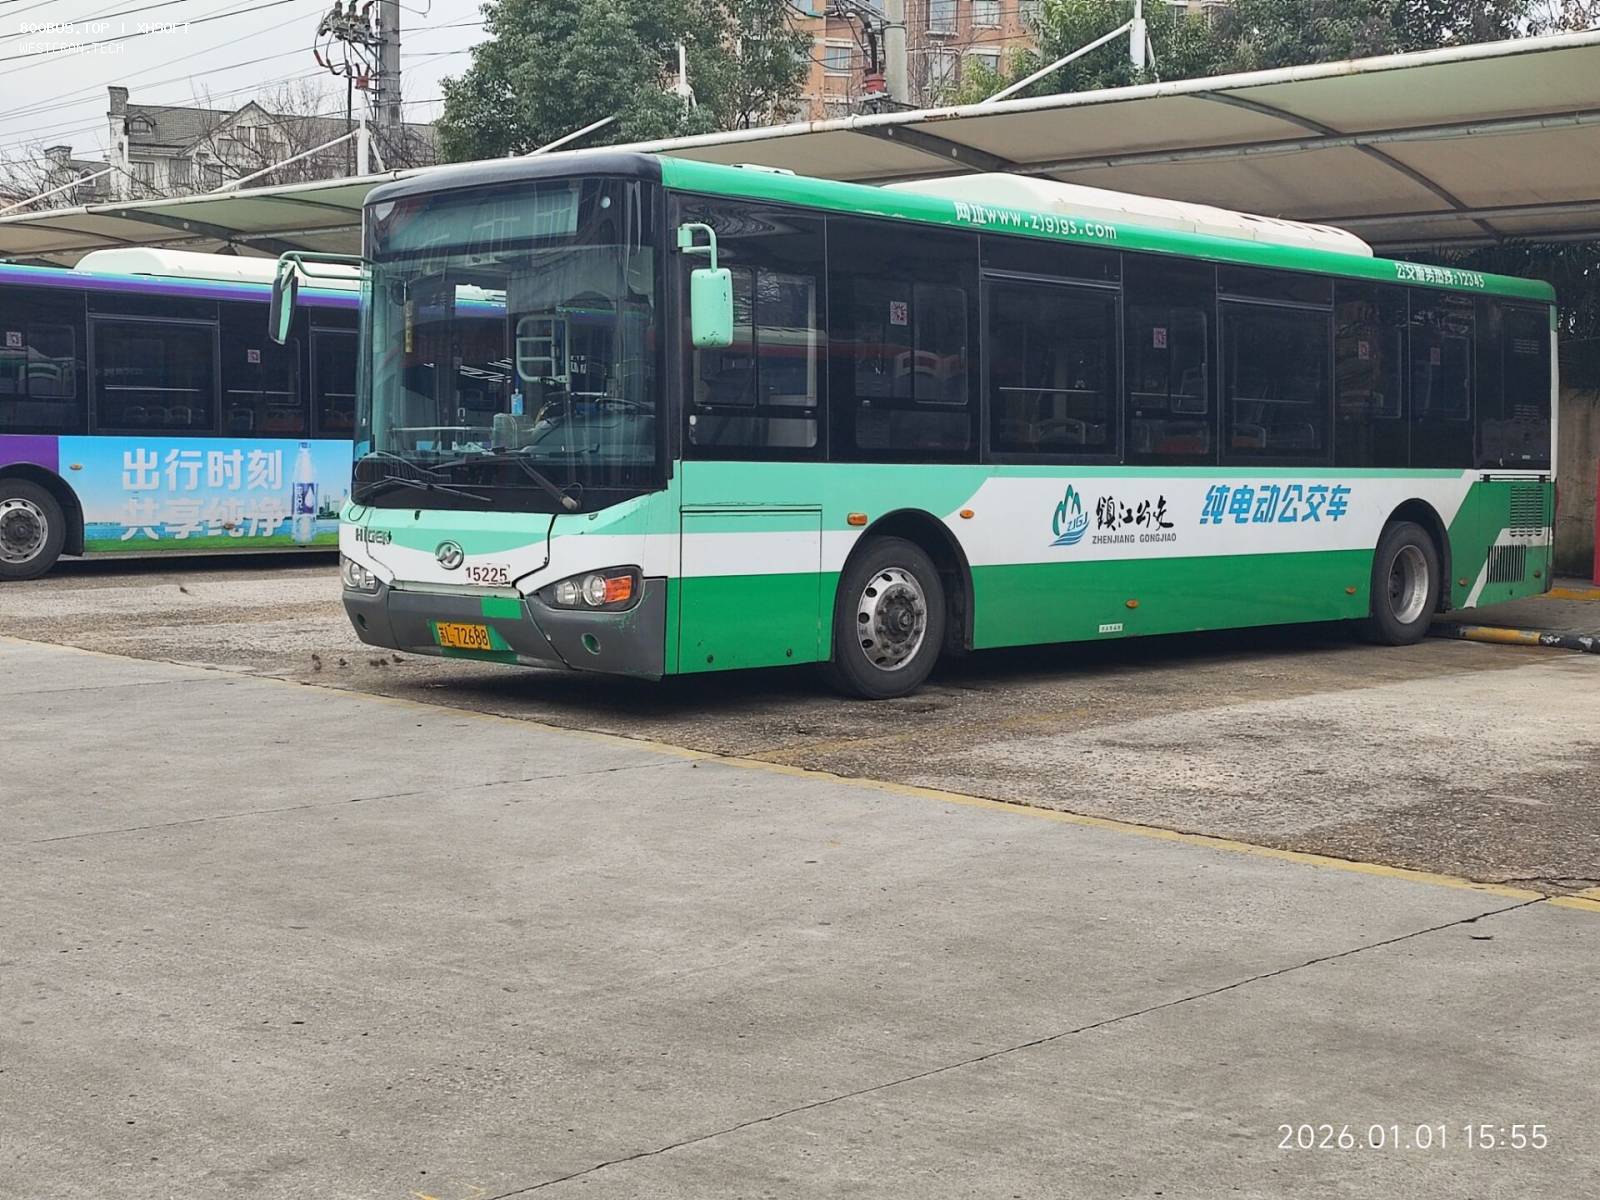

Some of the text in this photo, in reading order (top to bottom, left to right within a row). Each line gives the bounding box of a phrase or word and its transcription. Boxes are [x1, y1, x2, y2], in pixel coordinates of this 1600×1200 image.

[123, 448, 283, 491] 出行时刻
[121, 497, 285, 540] 共享纯净
[1200, 484, 1351, 524] 纯电动公交车
[1092, 533, 1176, 544] ZHENJIANG GONGJIAO
[465, 567, 508, 582] 15225
